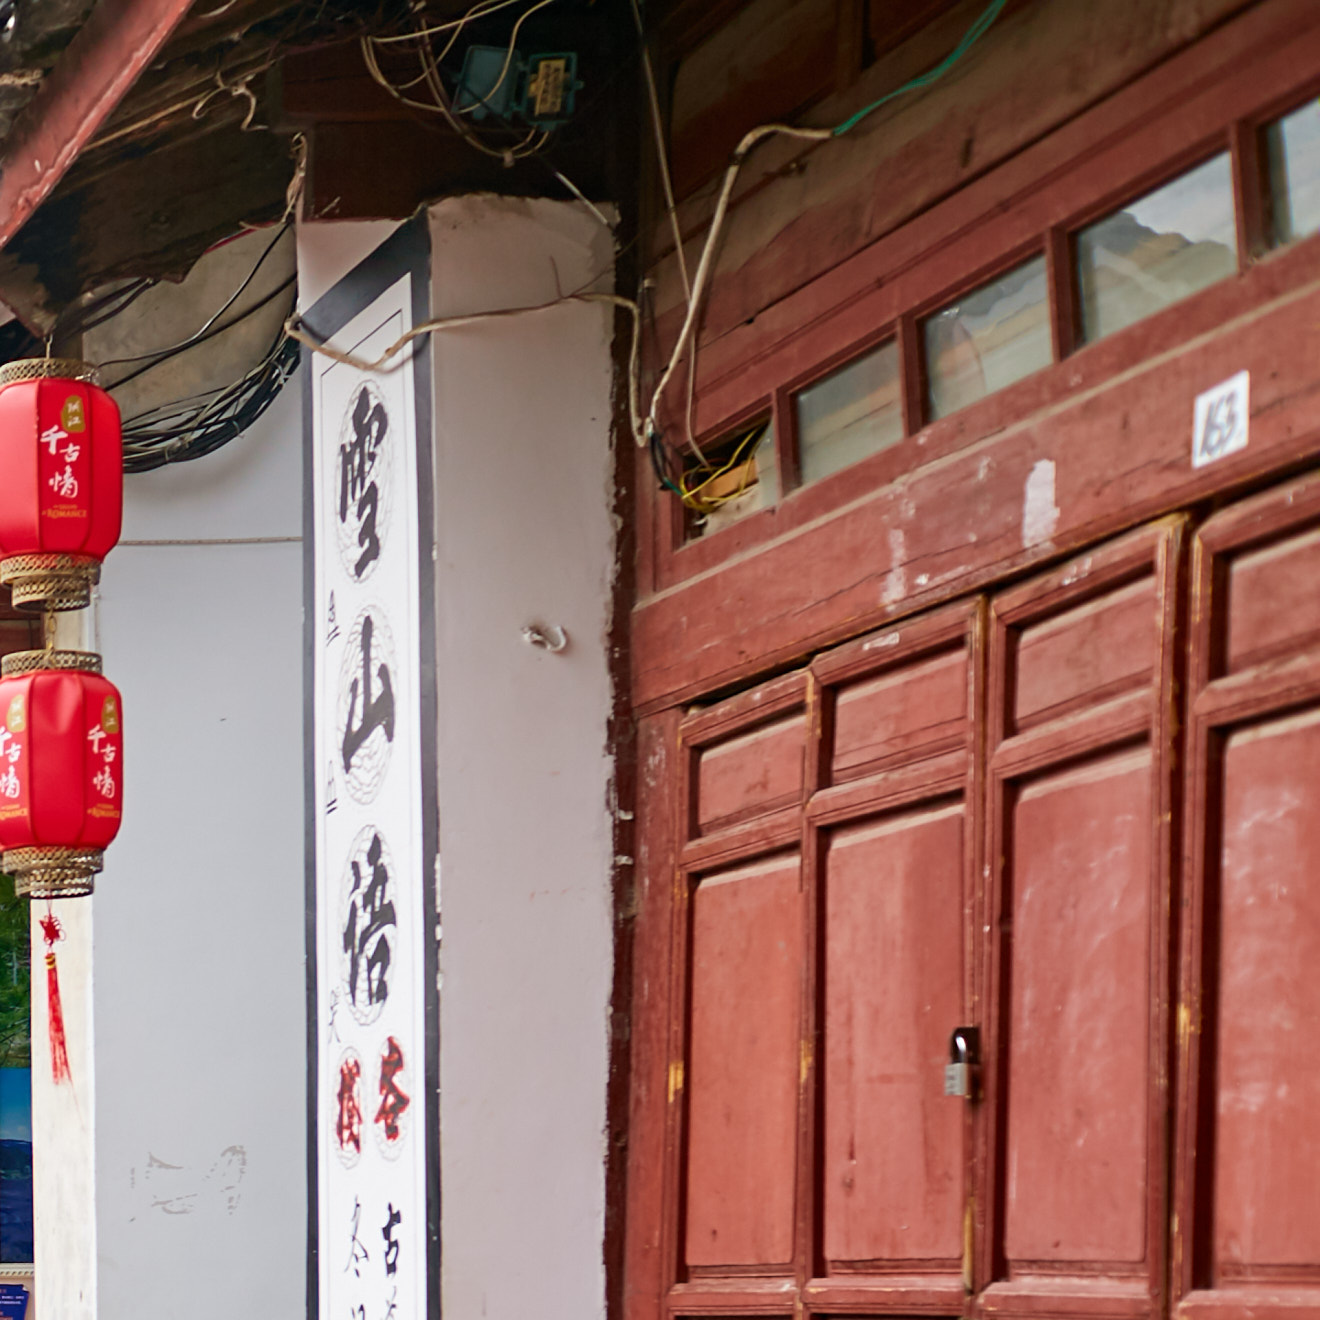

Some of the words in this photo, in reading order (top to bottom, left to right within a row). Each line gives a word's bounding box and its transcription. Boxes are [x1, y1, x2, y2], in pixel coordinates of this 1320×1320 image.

[40, 424, 80, 498] 千古情
[87, 724, 116, 798] 千古情
